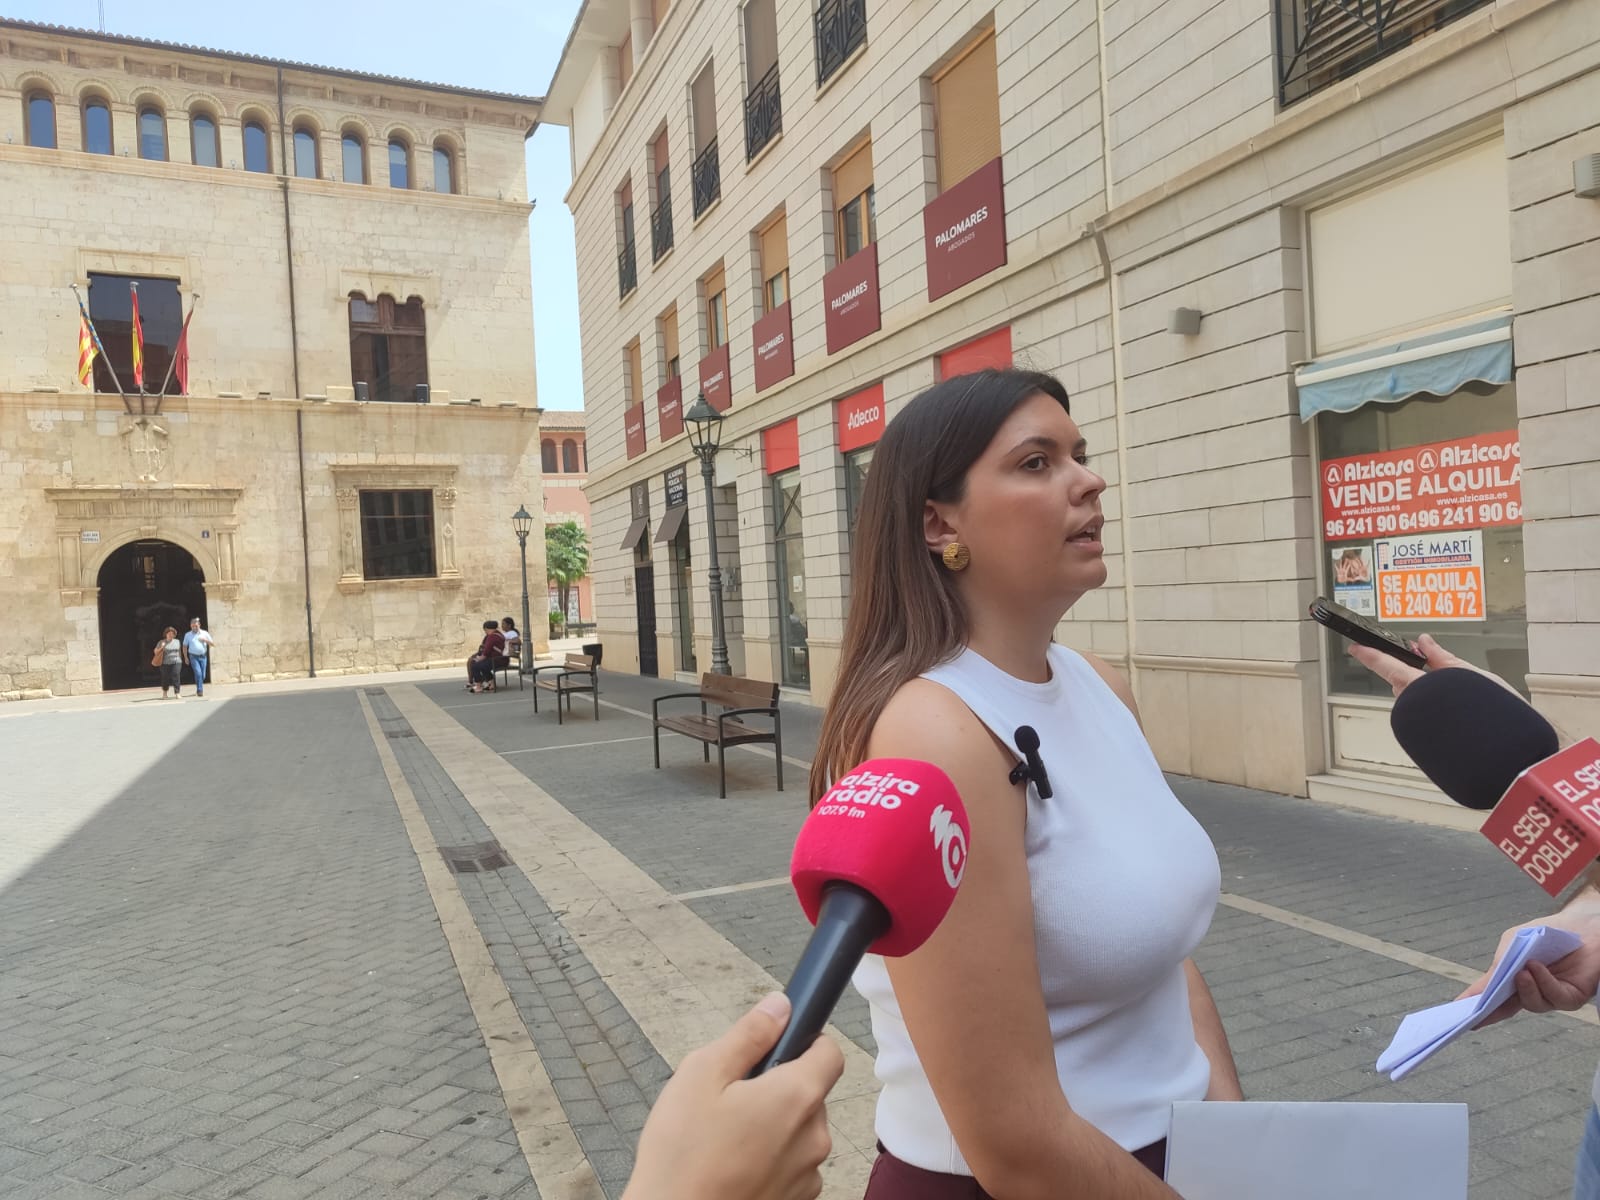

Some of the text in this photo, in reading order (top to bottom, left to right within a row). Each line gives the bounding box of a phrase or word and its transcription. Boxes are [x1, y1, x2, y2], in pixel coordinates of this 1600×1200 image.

[935, 206, 988, 249] PALOMARES
[948, 231, 976, 253] ABOGADOS
[831, 280, 868, 311] PALOMARES
[847, 405, 880, 431] Adecco
[1344, 459, 1414, 482] Alzicasa
[1417, 463, 1520, 496] ALQUILA
[1328, 478, 1412, 509] VENDE
[1436, 491, 1508, 506] www.alzicasa.es
[1326, 512, 1418, 537] 96 241 90 64
[1418, 501, 1522, 528] 96 241 90 6
[1392, 535, 1472, 558] JOSÉ MARTÍ
[1382, 570, 1478, 593] SE ALQUILA
[1384, 591, 1477, 616] 96 240 46 72
[841, 771, 920, 796] alzira
[1553, 779, 1590, 803] EL
[817, 805, 866, 819] 107.9 fm
[1499, 806, 1551, 862] EL SEIS
[1523, 827, 1579, 884] DOBLE
